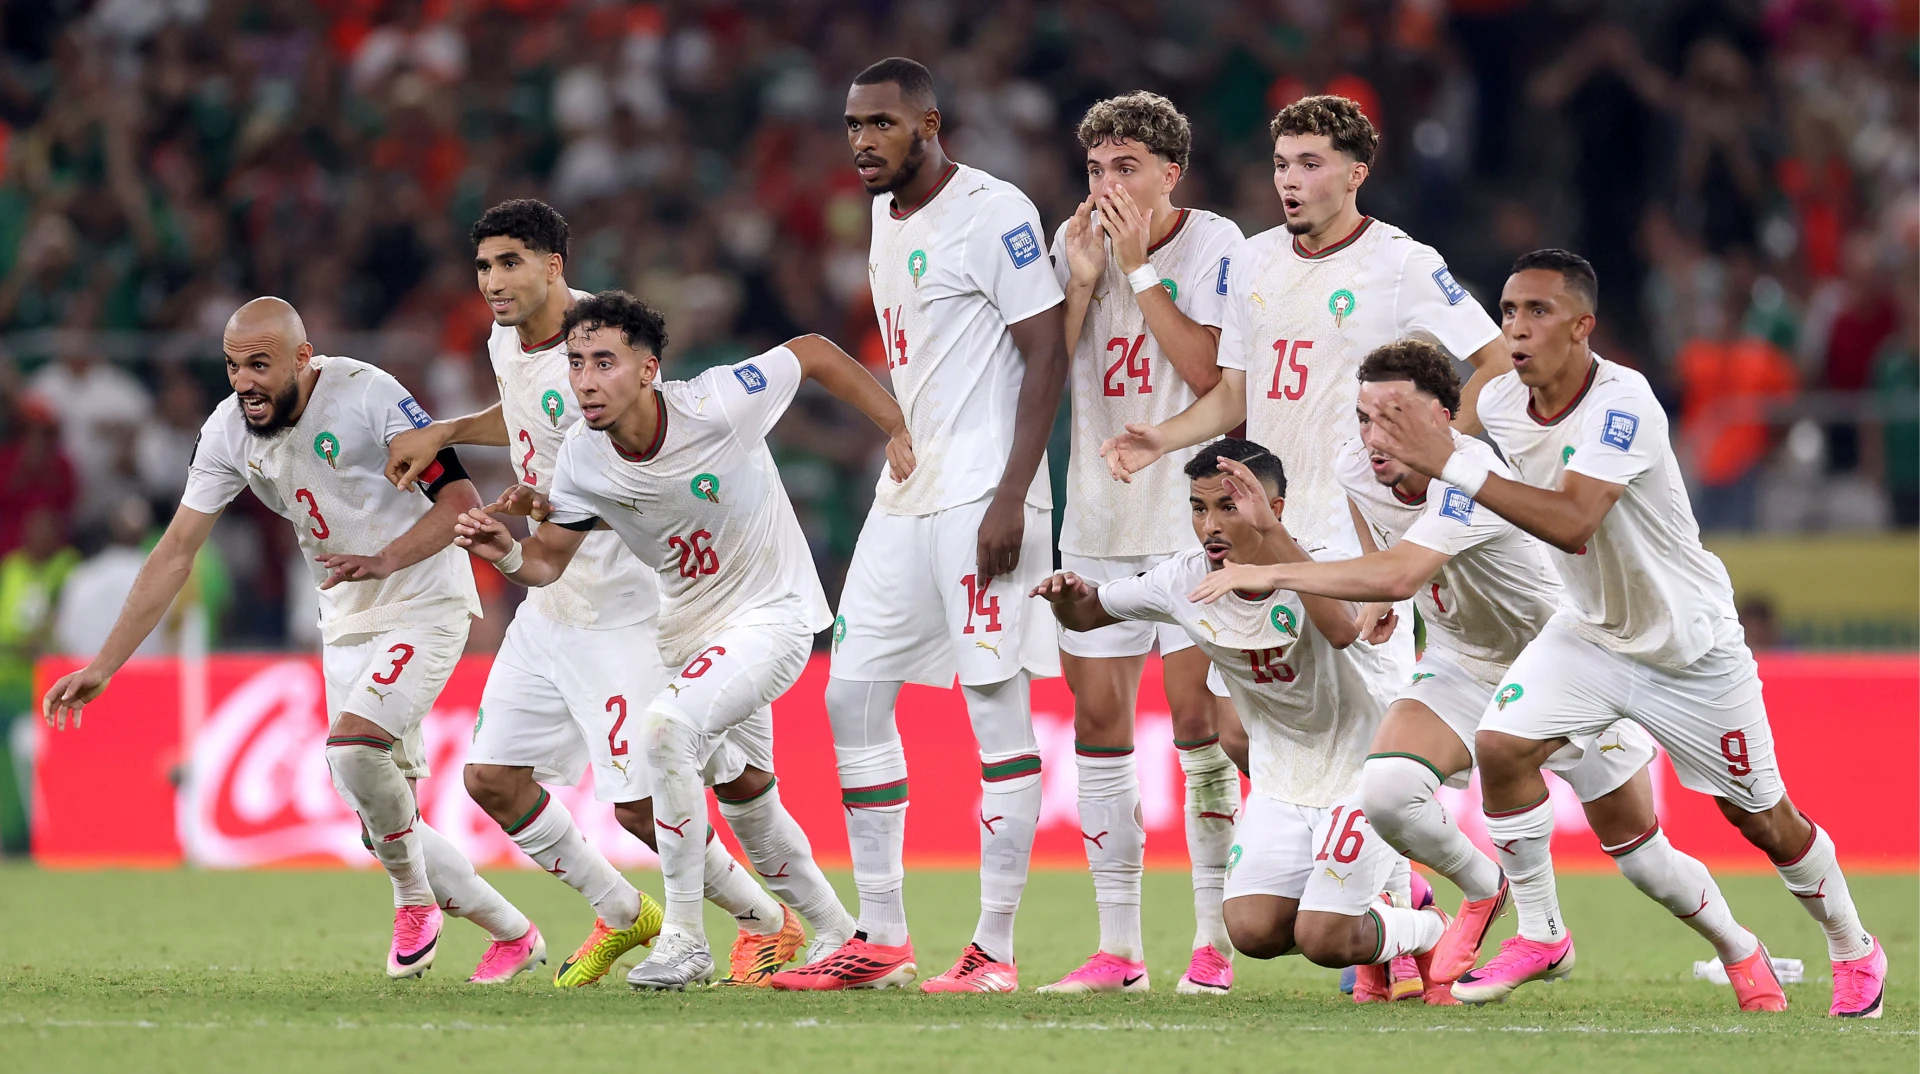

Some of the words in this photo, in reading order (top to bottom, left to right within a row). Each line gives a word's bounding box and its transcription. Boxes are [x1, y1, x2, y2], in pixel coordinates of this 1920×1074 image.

[1009, 229, 1030, 243] FOOTBALL
[1012, 237, 1032, 251] UNITES
[883, 304, 908, 370] 14
[1104, 334, 1153, 397] 24
[1267, 339, 1314, 401] 15
[1610, 421, 1633, 435] UNITES
[1612, 415, 1634, 425] FOOTBALL
[519, 429, 537, 486] 2
[295, 488, 330, 540] 3
[669, 530, 720, 579] 26
[960, 574, 1002, 634] 14
[372, 643, 415, 685] 3
[1241, 647, 1295, 684] 16
[606, 695, 628, 756] 2
[1721, 729, 1752, 777] 9
[1315, 805, 1370, 864] 16
